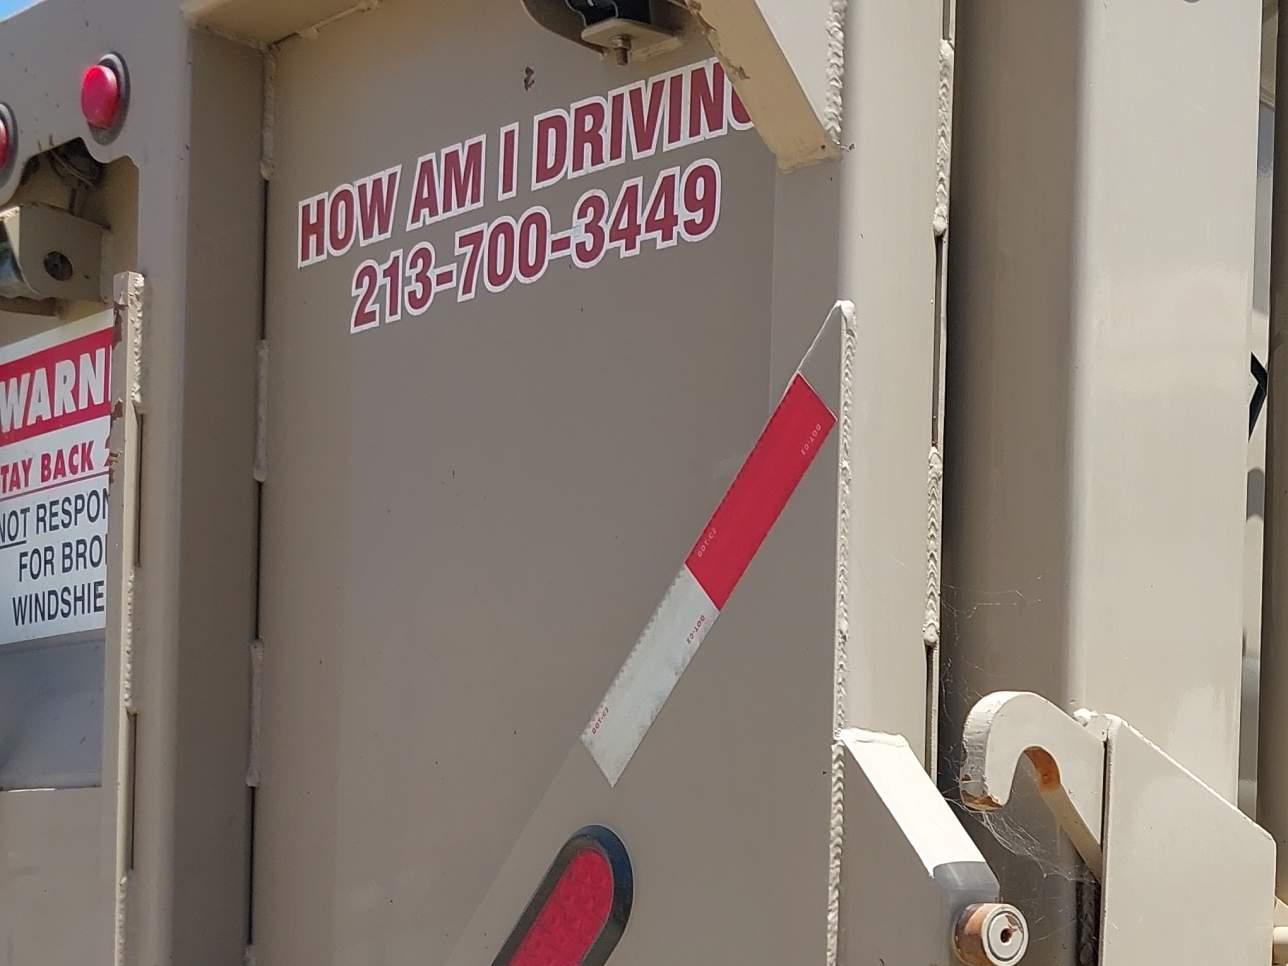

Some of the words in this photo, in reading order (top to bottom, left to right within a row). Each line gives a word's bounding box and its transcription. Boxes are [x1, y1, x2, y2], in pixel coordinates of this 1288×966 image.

[298, 165, 401, 268] HOW
[407, 134, 486, 231] AM
[498, 122, 518, 201] I
[351, 158, 722, 333] 213-700-3449
[0, 345, 112, 433] WARN
[41, 440, 94, 483] BACK
[19, 546, 54, 582] FOR
[62, 533, 107, 573] BRO
[13, 580, 104, 626] WINDSHIE
